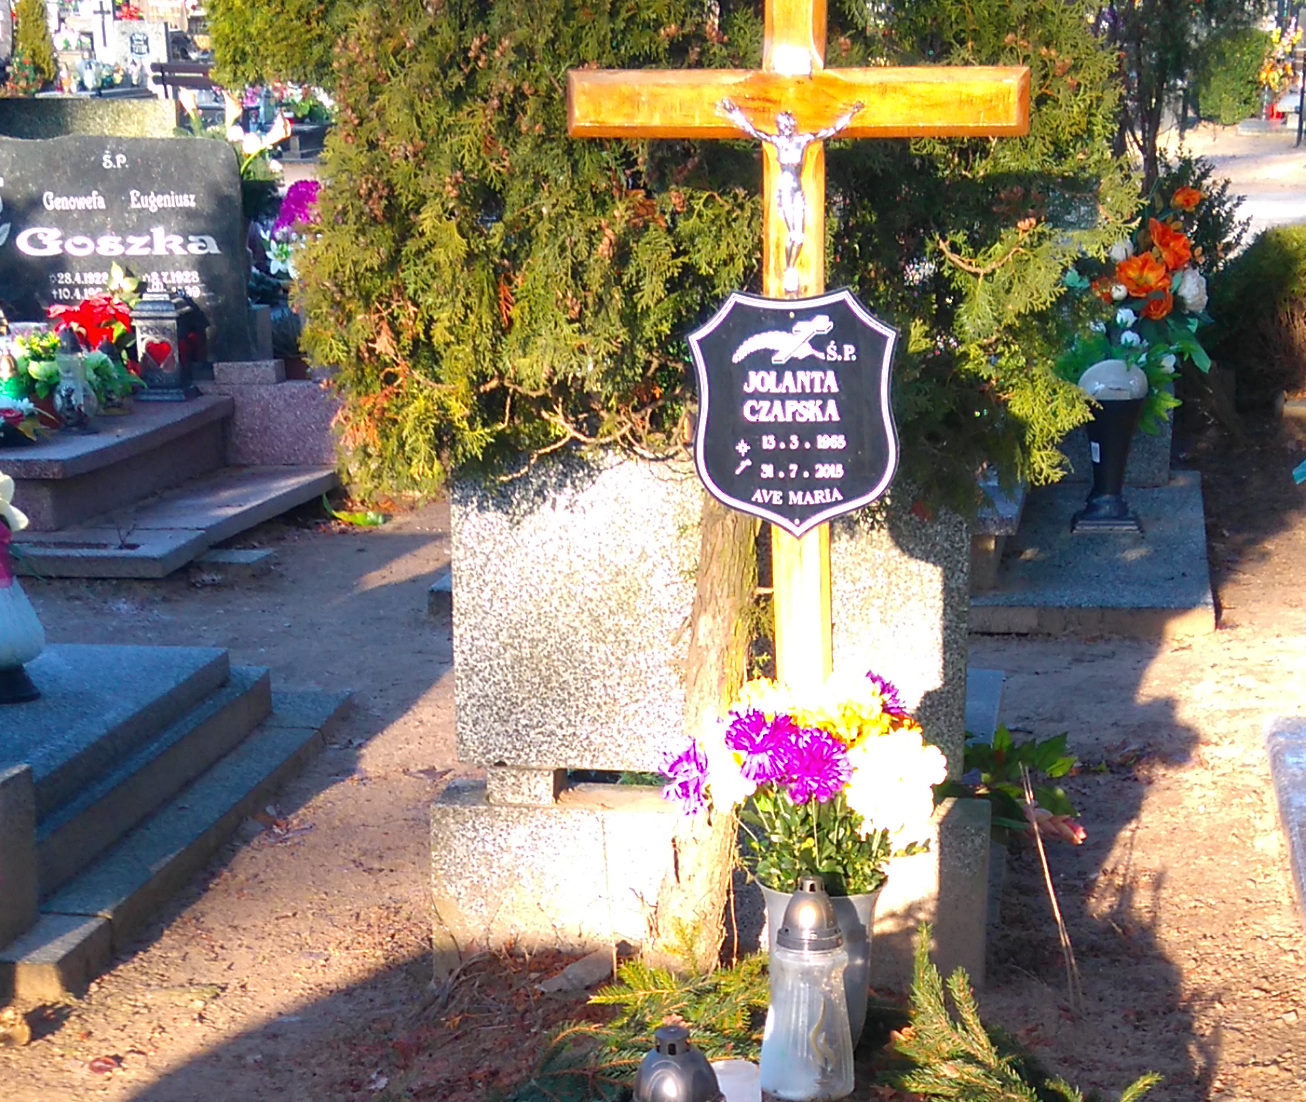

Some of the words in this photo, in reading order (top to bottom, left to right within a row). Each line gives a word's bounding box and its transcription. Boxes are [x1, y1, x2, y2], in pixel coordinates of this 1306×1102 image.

[42, 190, 106, 211] Genowefa
[130, 189, 196, 213] Eugeniusz
[15, 226, 222, 257] Goszka
[744, 371, 839, 393] JOLANTA
[743, 400, 840, 422] CZAPSKA
[751, 489, 783, 504] AVE
[788, 488, 844, 505] MARIA
